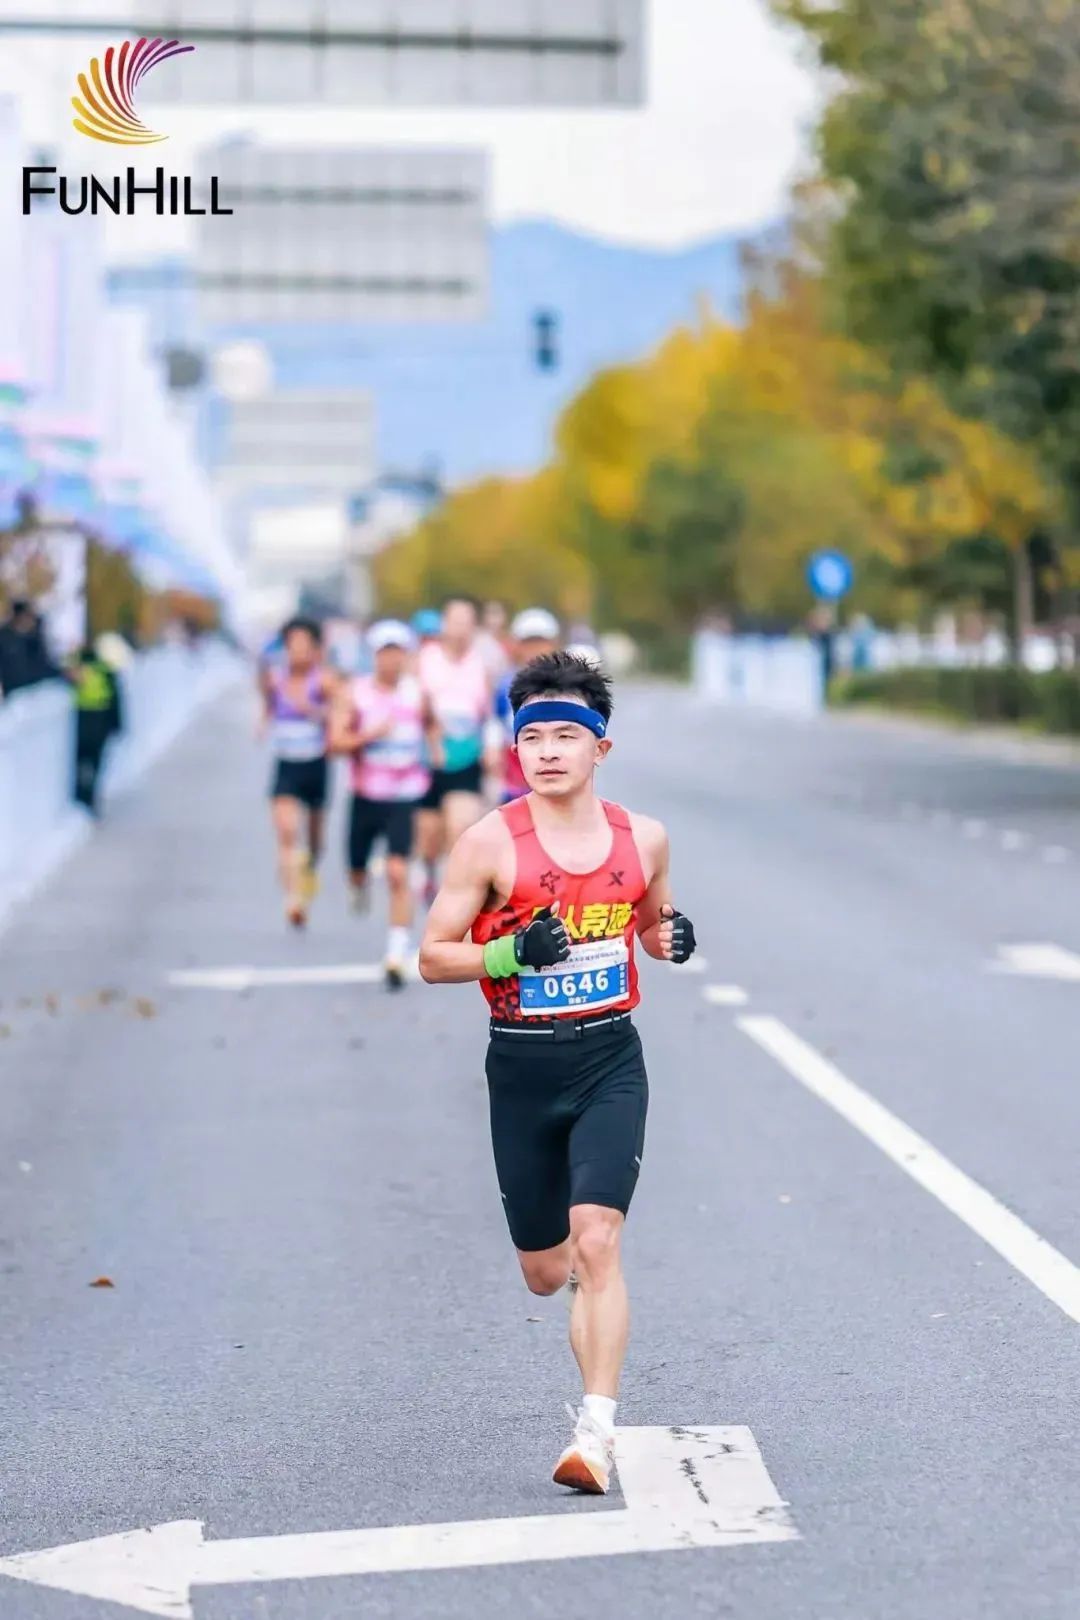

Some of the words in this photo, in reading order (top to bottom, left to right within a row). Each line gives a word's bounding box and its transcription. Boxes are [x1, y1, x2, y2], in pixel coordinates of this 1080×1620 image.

[532, 902, 633, 939] 人竞速
[544, 970, 609, 998] 0646
